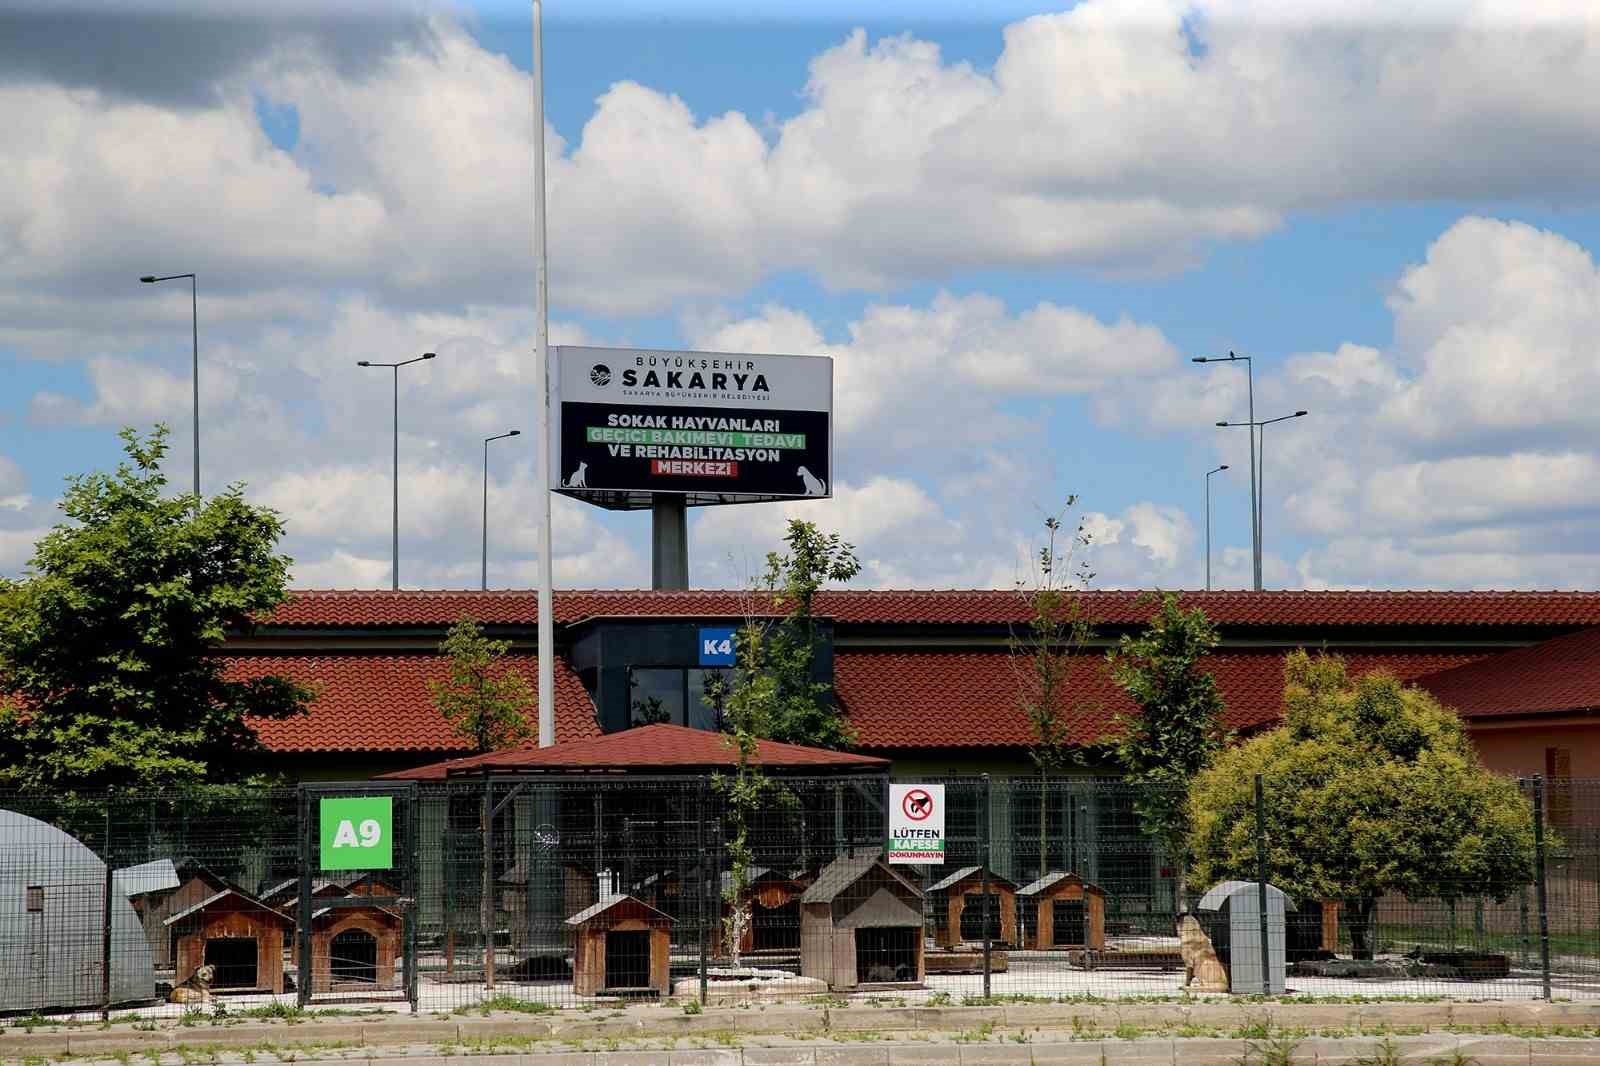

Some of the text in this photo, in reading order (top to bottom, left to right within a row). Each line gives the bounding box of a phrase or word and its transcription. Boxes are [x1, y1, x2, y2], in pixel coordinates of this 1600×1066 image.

[622, 369, 770, 392] SAKARYA
[608, 414, 780, 432] SOKAK HAYVANLARI
[608, 443, 631, 457] VE
[704, 639, 732, 655] K4
[332, 819, 382, 848] A9
[894, 827, 940, 838] LÜTFEN
[894, 839, 939, 850] KAFESE
